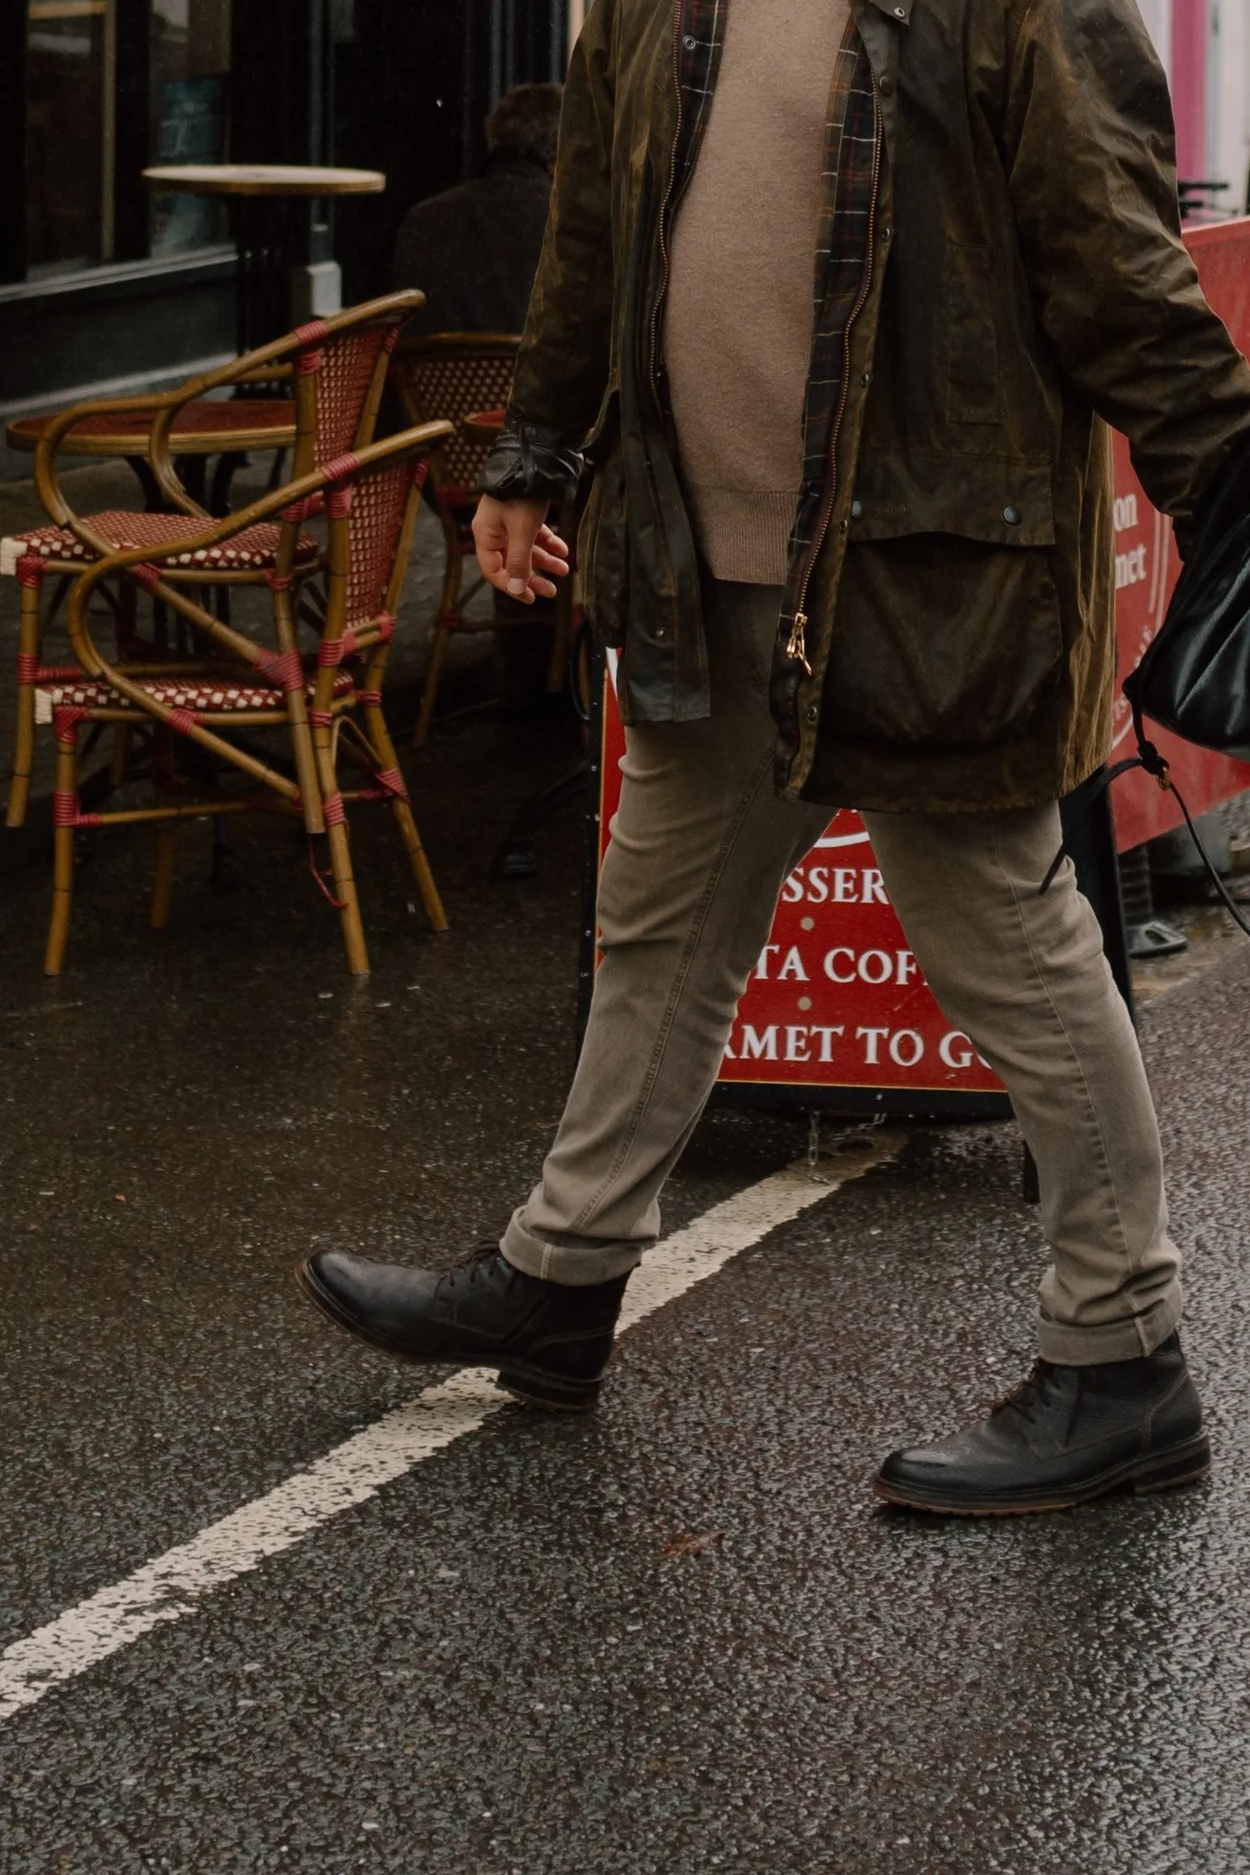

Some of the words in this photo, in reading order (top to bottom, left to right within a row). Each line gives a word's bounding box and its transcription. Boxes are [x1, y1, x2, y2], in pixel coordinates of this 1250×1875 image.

[823, 947, 927, 987] COF
[855, 1027, 924, 1067] TO
[939, 1031, 992, 1069] G
